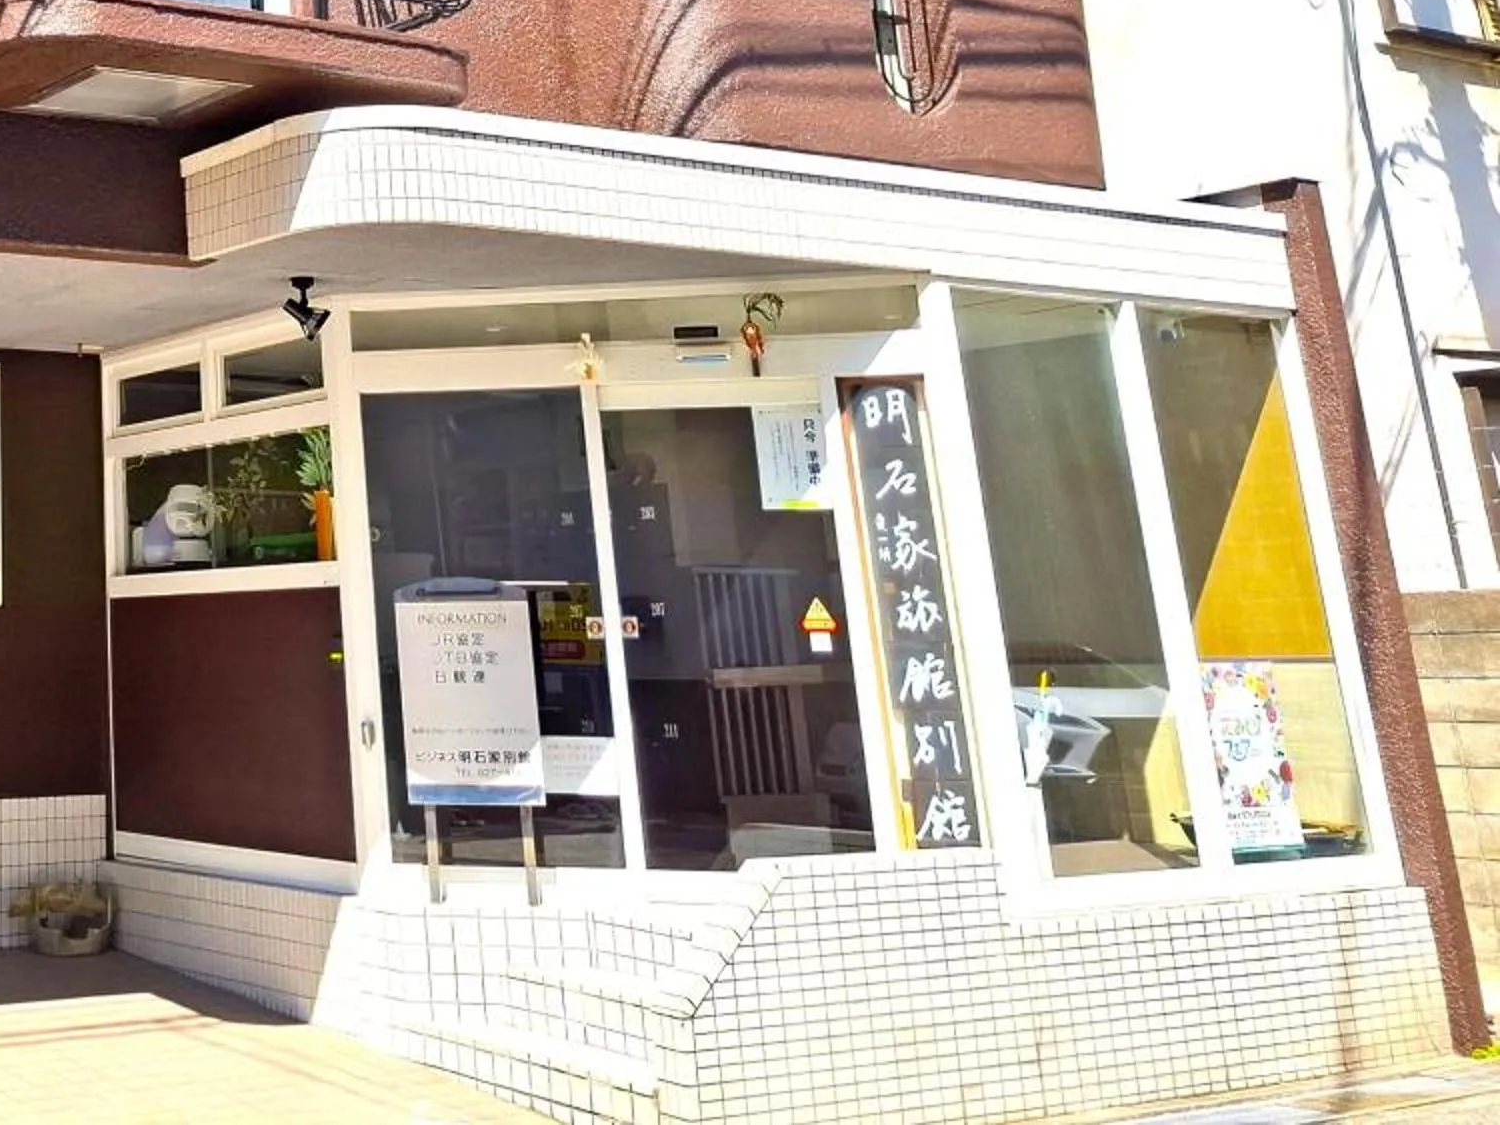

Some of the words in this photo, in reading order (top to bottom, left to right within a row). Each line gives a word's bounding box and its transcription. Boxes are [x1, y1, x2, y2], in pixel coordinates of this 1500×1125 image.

[803, 418, 817, 444] 只今
[417, 612, 507, 625] INFORMATION
[861, 388, 972, 842] 明石家旅館別館
